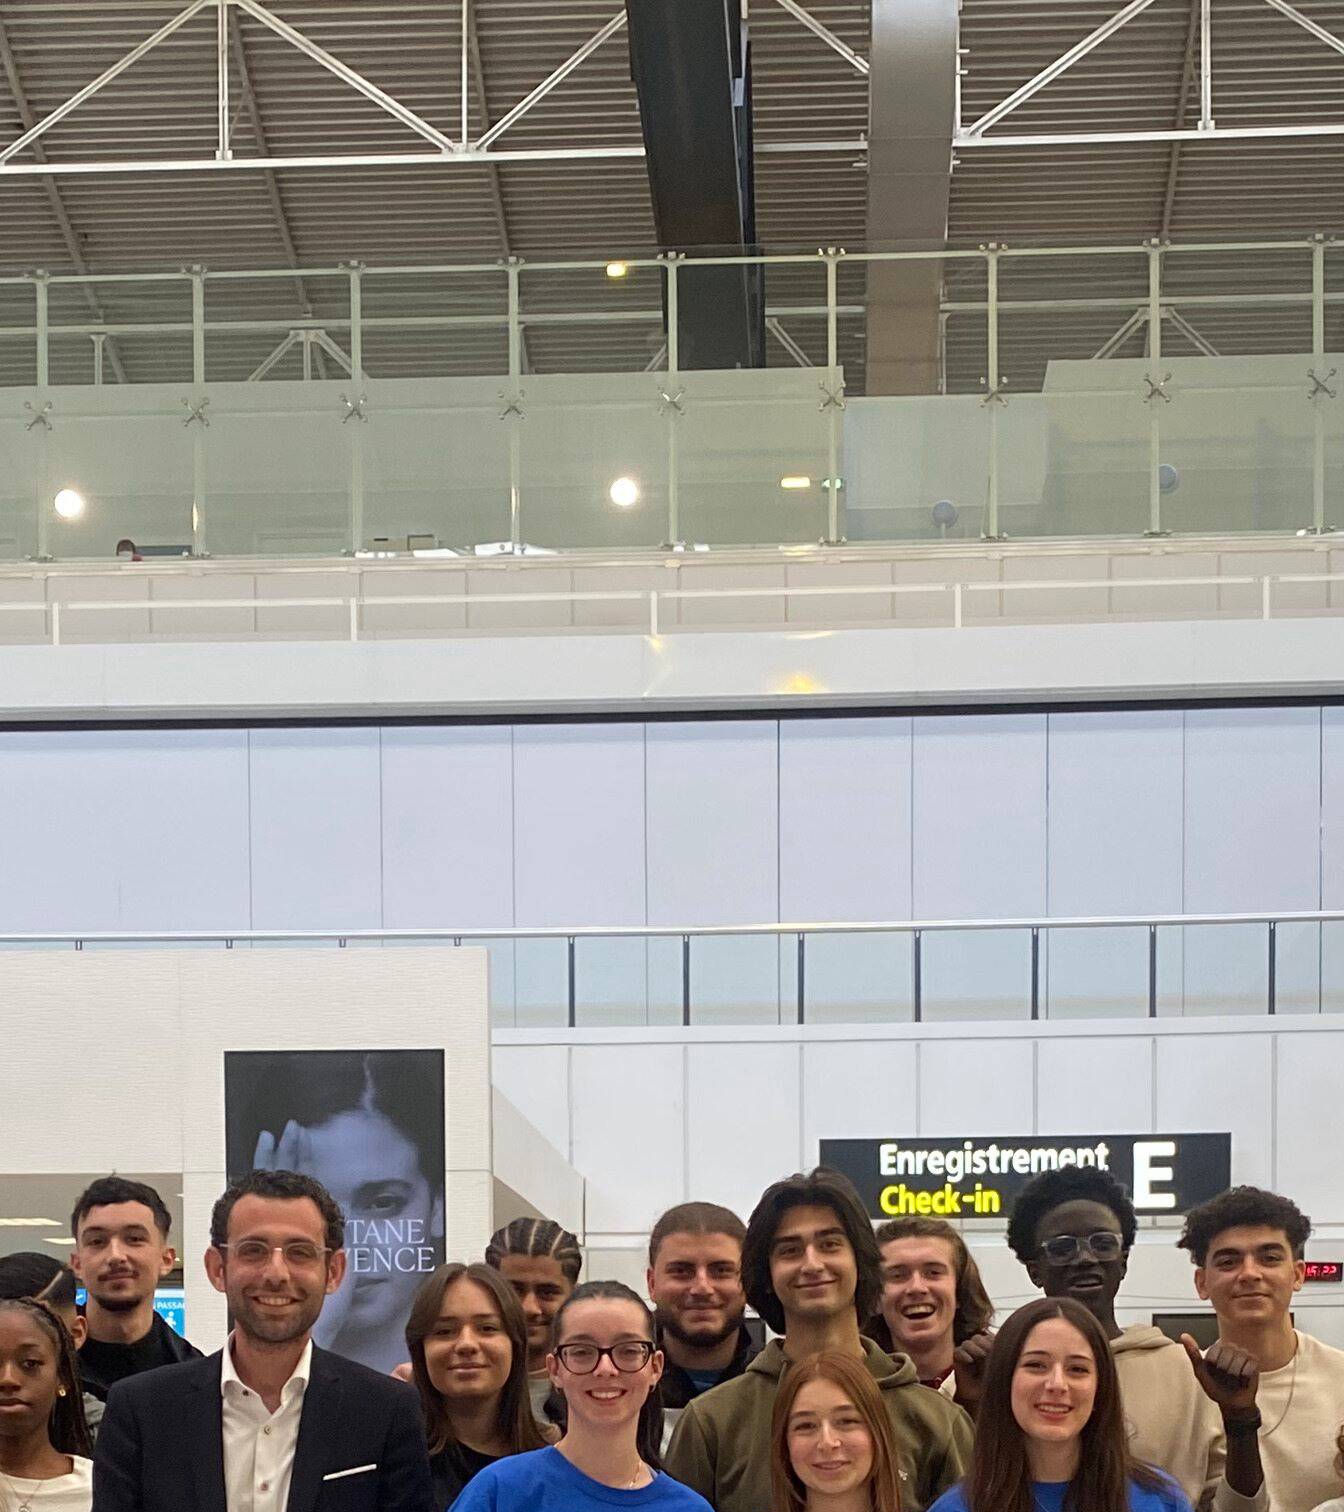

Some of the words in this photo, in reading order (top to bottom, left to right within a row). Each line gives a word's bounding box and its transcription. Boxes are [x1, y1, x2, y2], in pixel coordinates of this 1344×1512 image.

[878, 1140, 1110, 1183] Enregistrement
[1131, 1140, 1177, 1209] E
[879, 1182, 1002, 1217] Check-in
[344, 1218, 426, 1245] TANE
